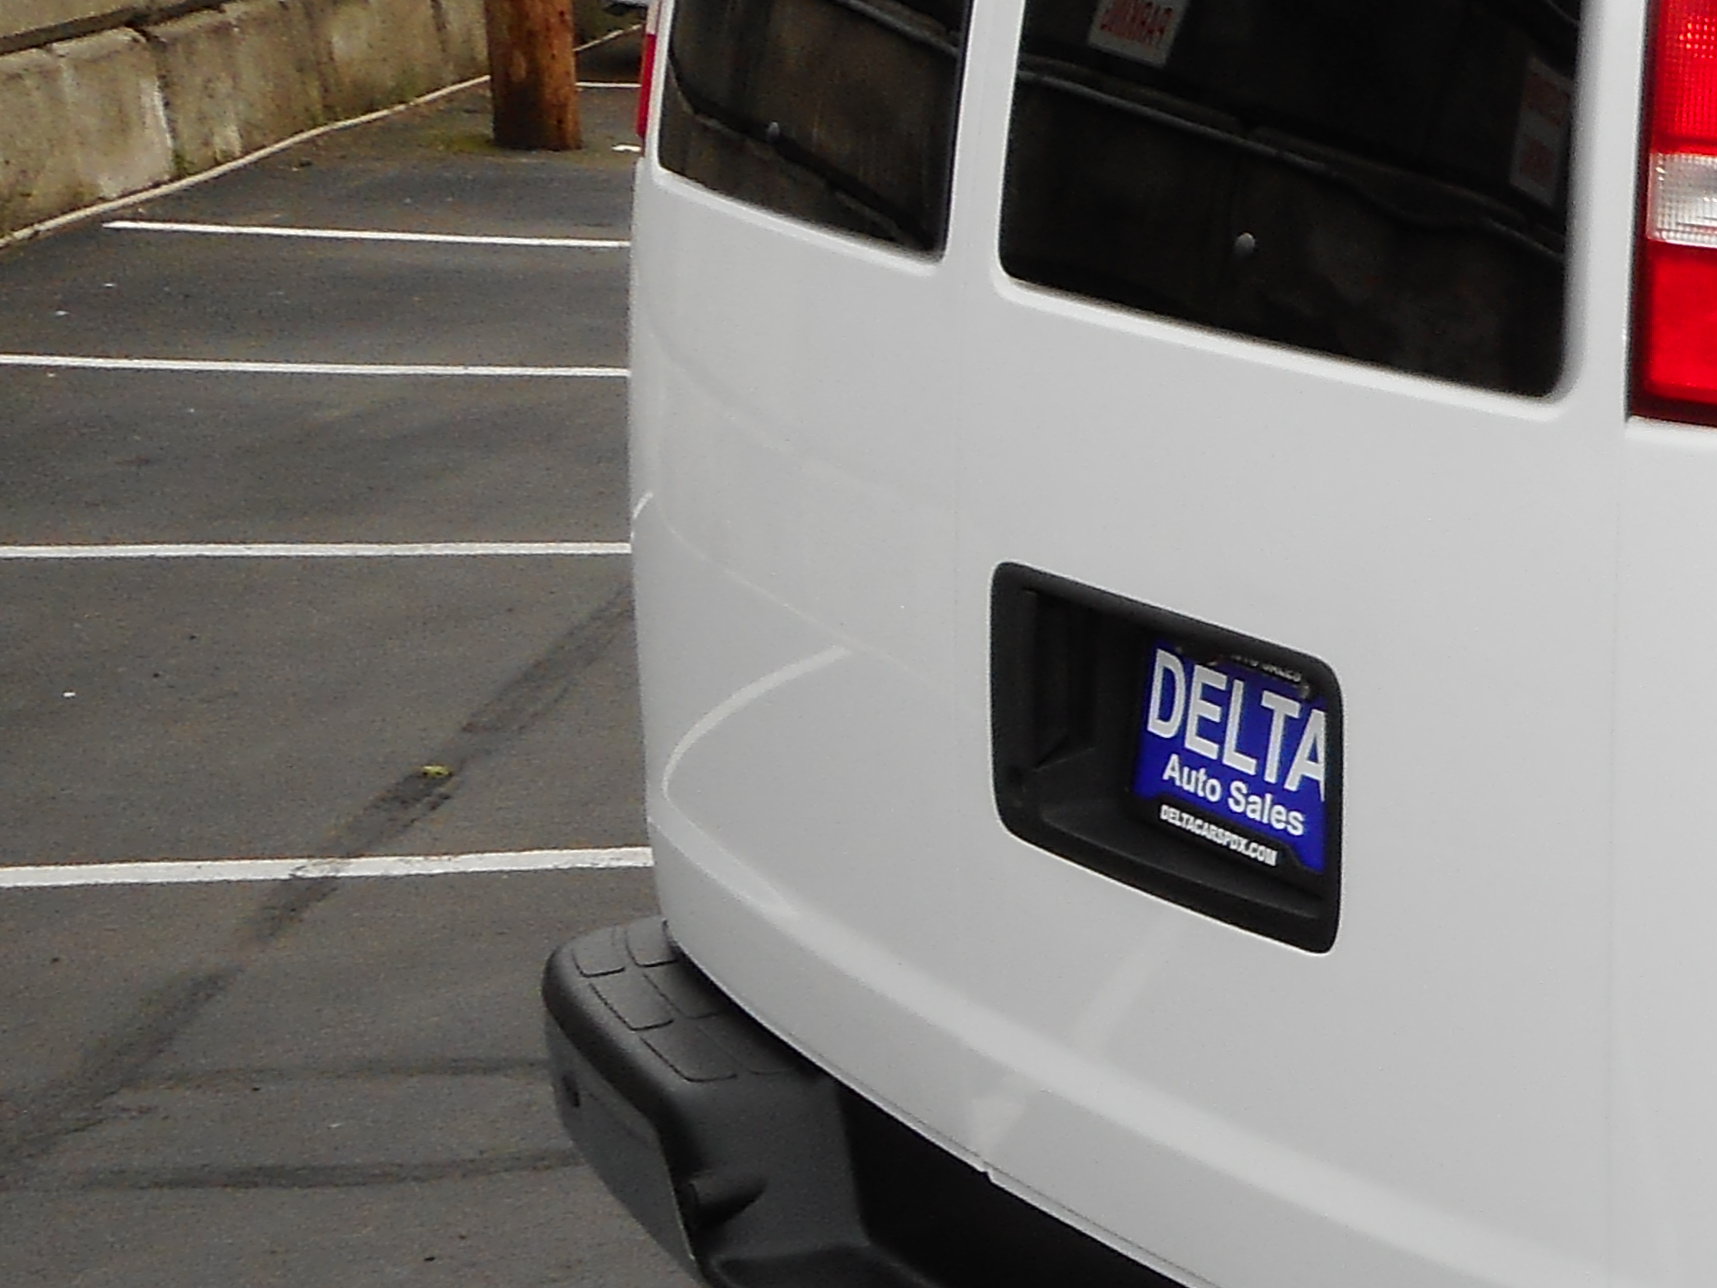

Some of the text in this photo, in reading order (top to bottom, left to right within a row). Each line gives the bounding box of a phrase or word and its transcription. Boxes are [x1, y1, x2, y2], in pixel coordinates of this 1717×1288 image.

[1147, 648, 1327, 802] DELTA
[1159, 804, 1278, 867] DELTACARSPDX.COM
[1162, 753, 1305, 837] Auto Sales
